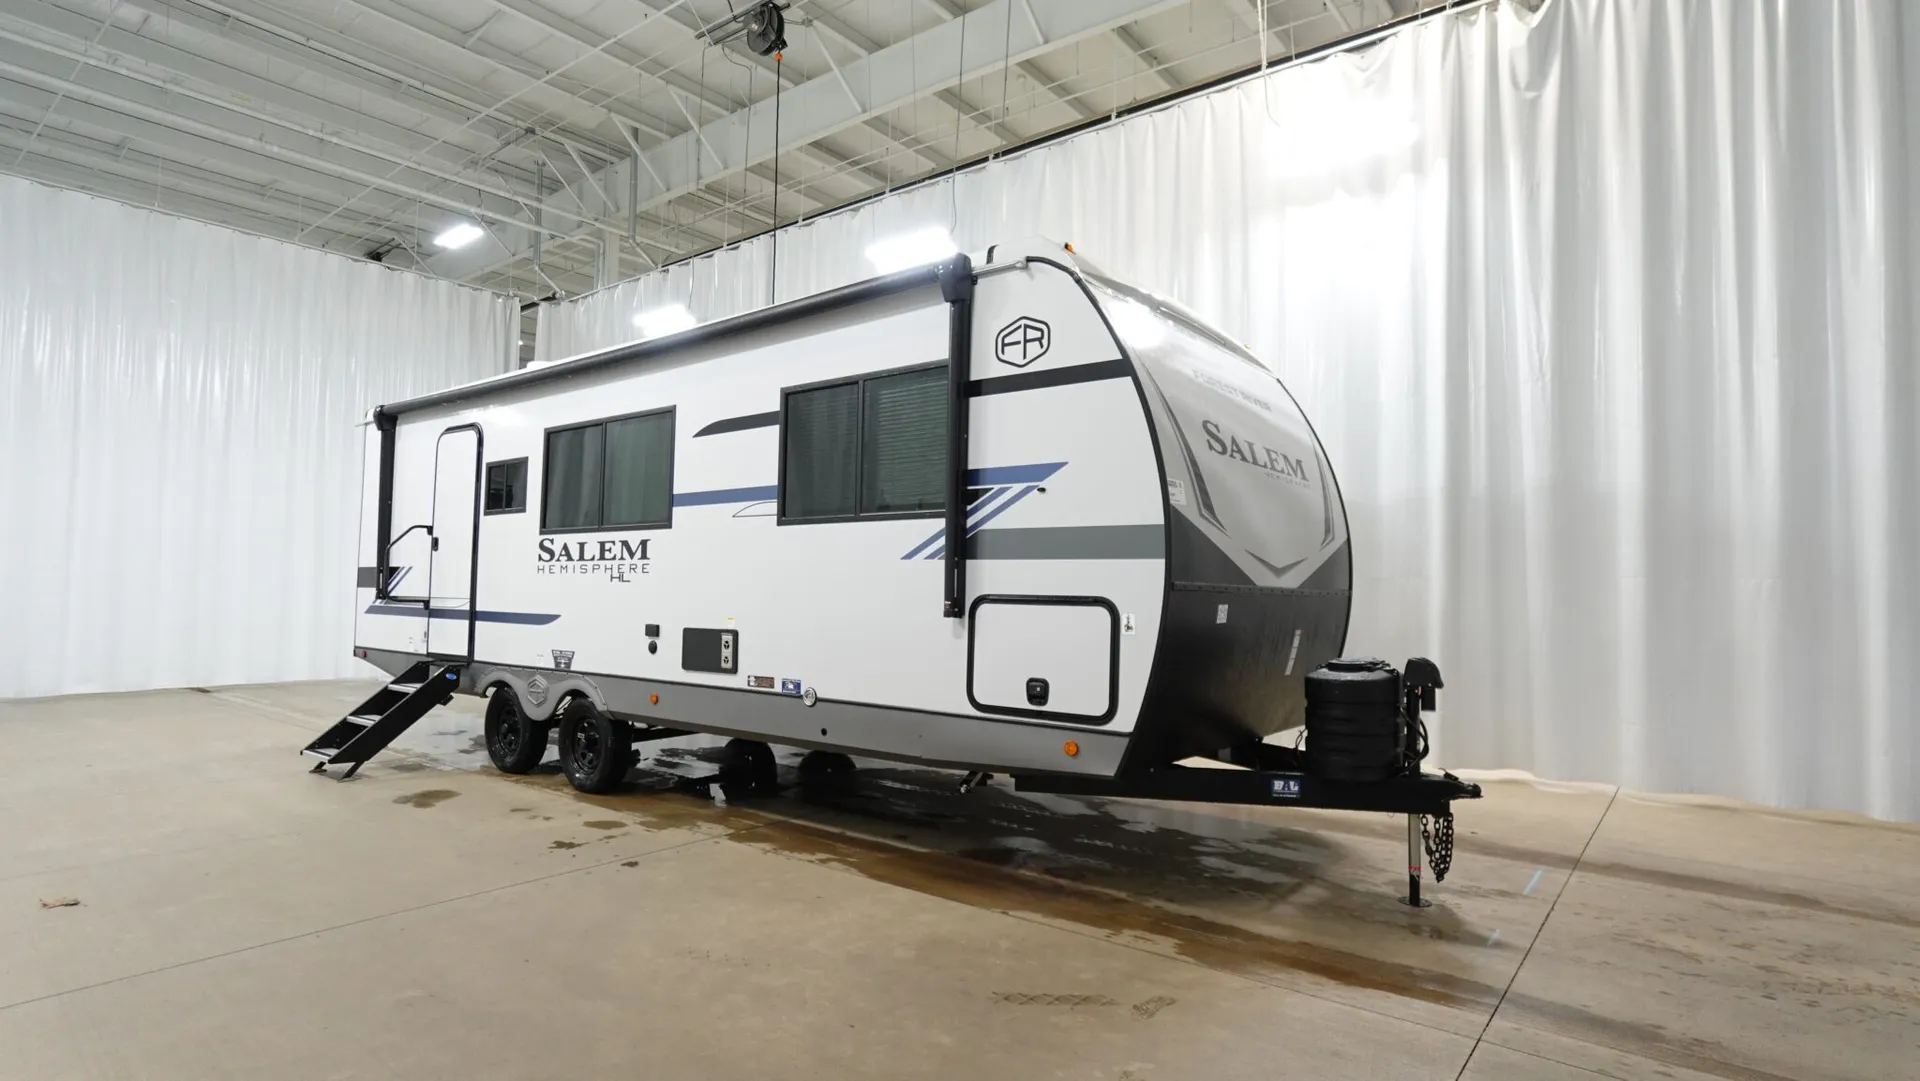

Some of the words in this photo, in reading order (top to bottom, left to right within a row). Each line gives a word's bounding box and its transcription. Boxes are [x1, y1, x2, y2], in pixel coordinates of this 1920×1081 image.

[1202, 419, 1309, 482] SALEM
[538, 537, 652, 563] SALEM
[537, 563, 650, 575] HEMISPHERE
[609, 573, 631, 583] HL
